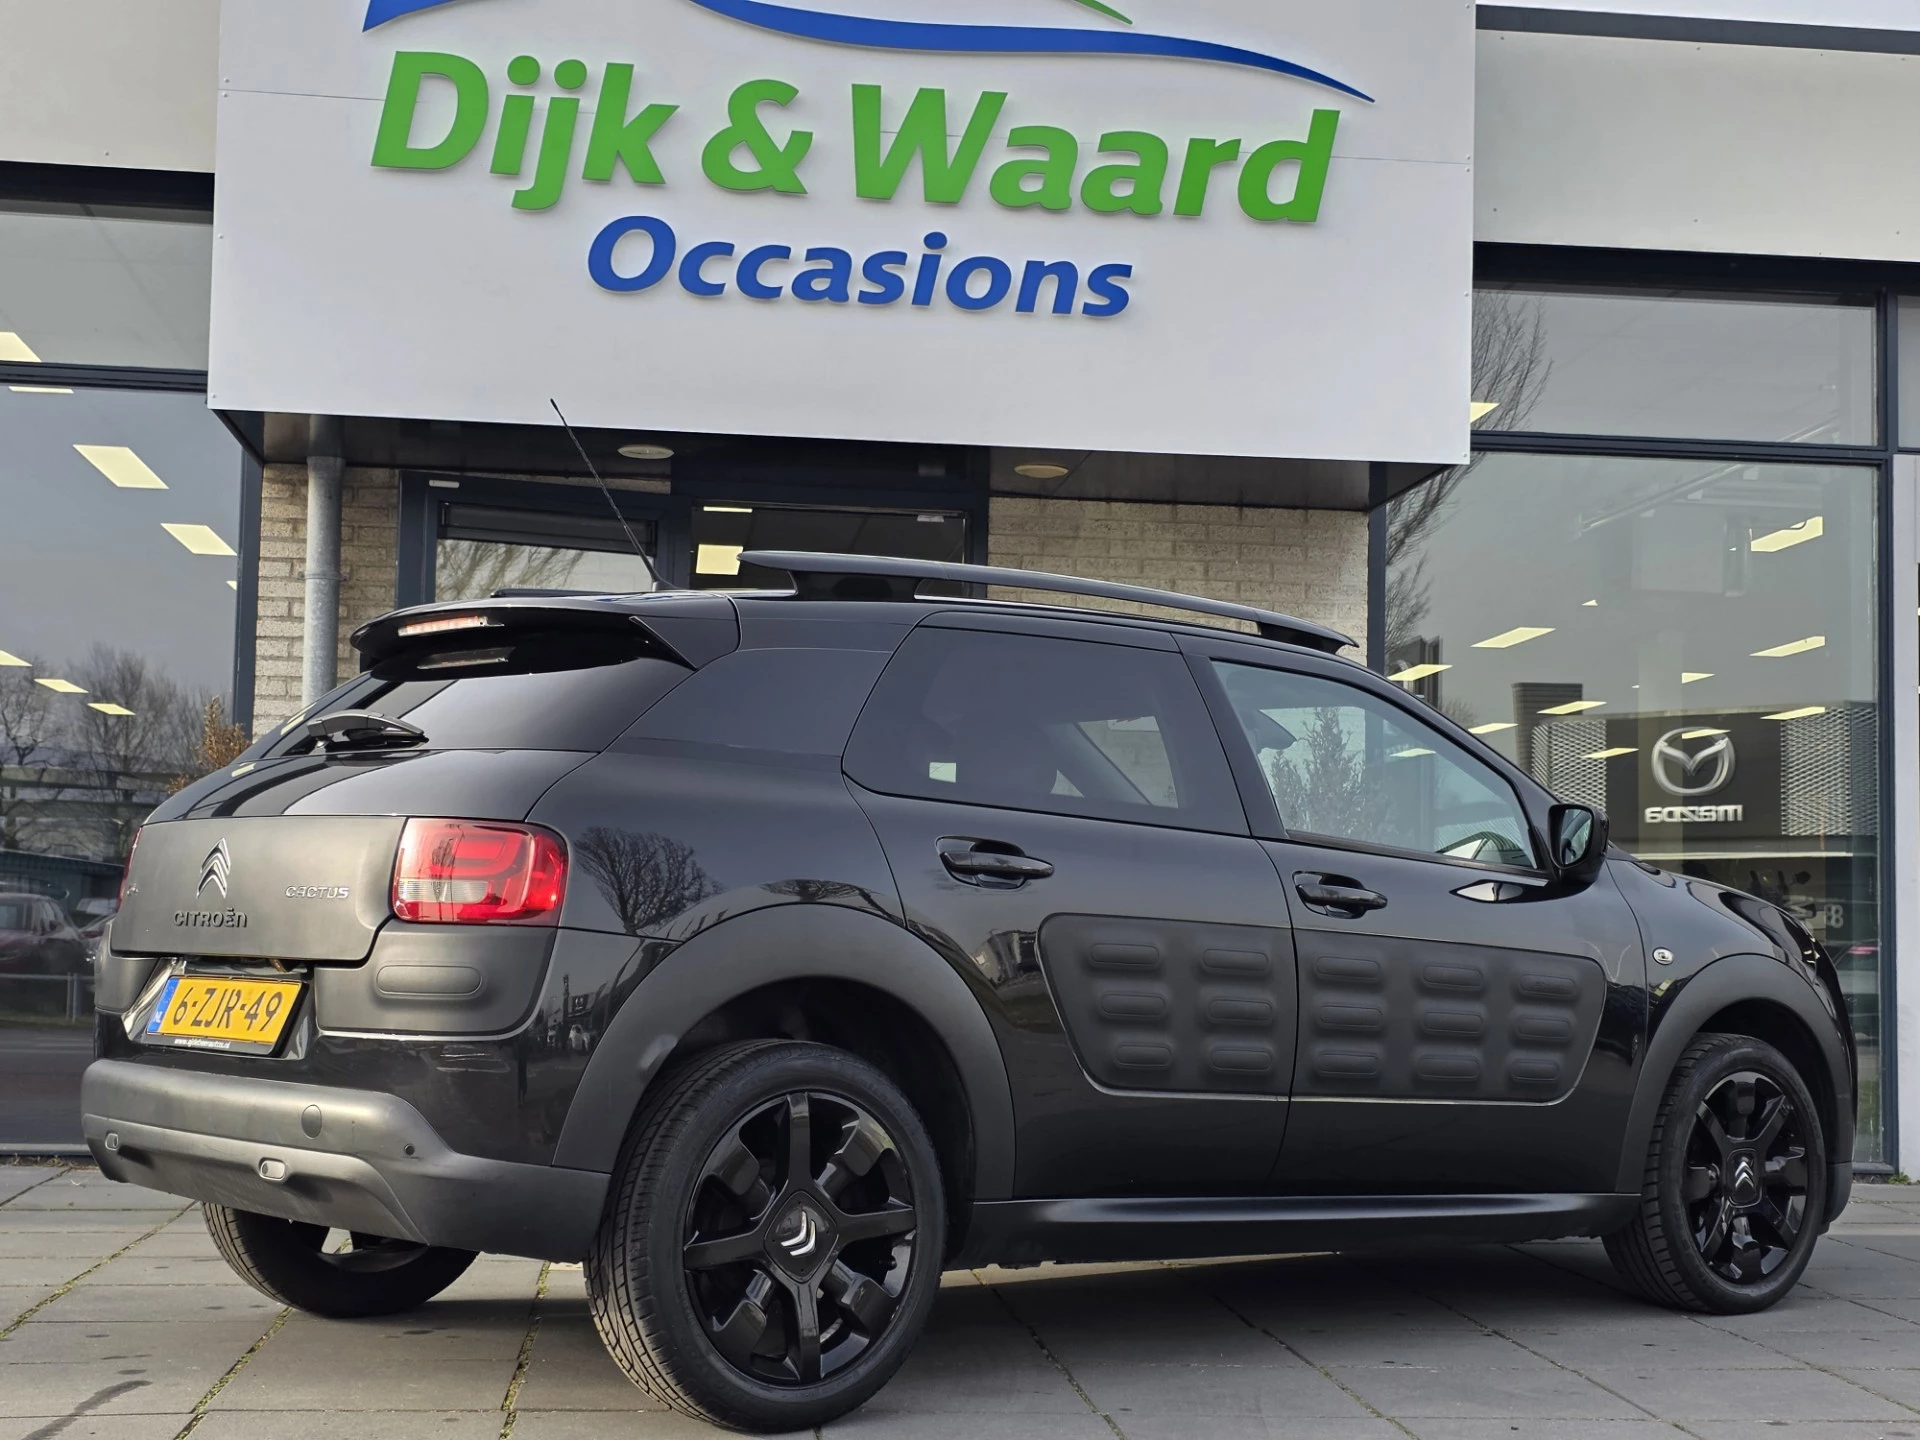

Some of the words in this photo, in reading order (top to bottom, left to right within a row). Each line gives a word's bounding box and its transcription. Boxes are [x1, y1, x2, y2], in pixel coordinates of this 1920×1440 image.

[371, 50, 680, 211] Dijk
[701, 79, 814, 194] &
[852, 84, 1341, 222] Waard
[588, 215, 1133, 316] Occasions
[285, 886, 349, 898] CACTUS
[173, 986, 283, 1031] 6-ZJR-49
